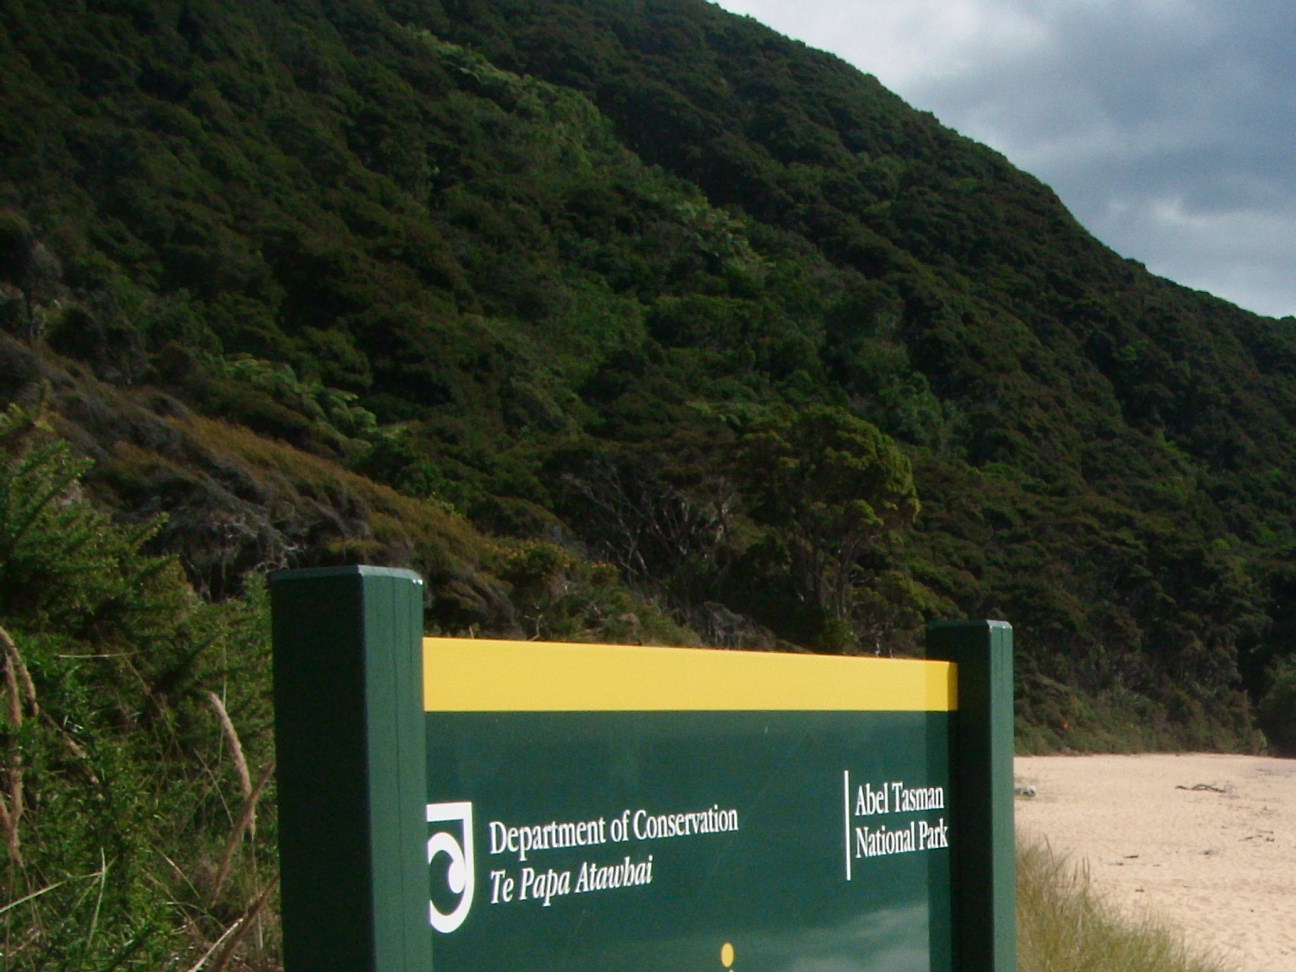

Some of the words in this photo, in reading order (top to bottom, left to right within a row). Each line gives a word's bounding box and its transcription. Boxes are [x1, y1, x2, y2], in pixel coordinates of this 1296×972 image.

[855, 783, 889, 815] Abel
[892, 782, 944, 812] Tasman
[490, 817, 606, 861] Department
[611, 809, 632, 842] of
[635, 804, 738, 839] Conservation
[856, 822, 916, 858] National
[919, 817, 948, 850] Park
[491, 870, 513, 904] Te
[520, 867, 570, 906] Papa
[575, 854, 653, 892] Atawhai
